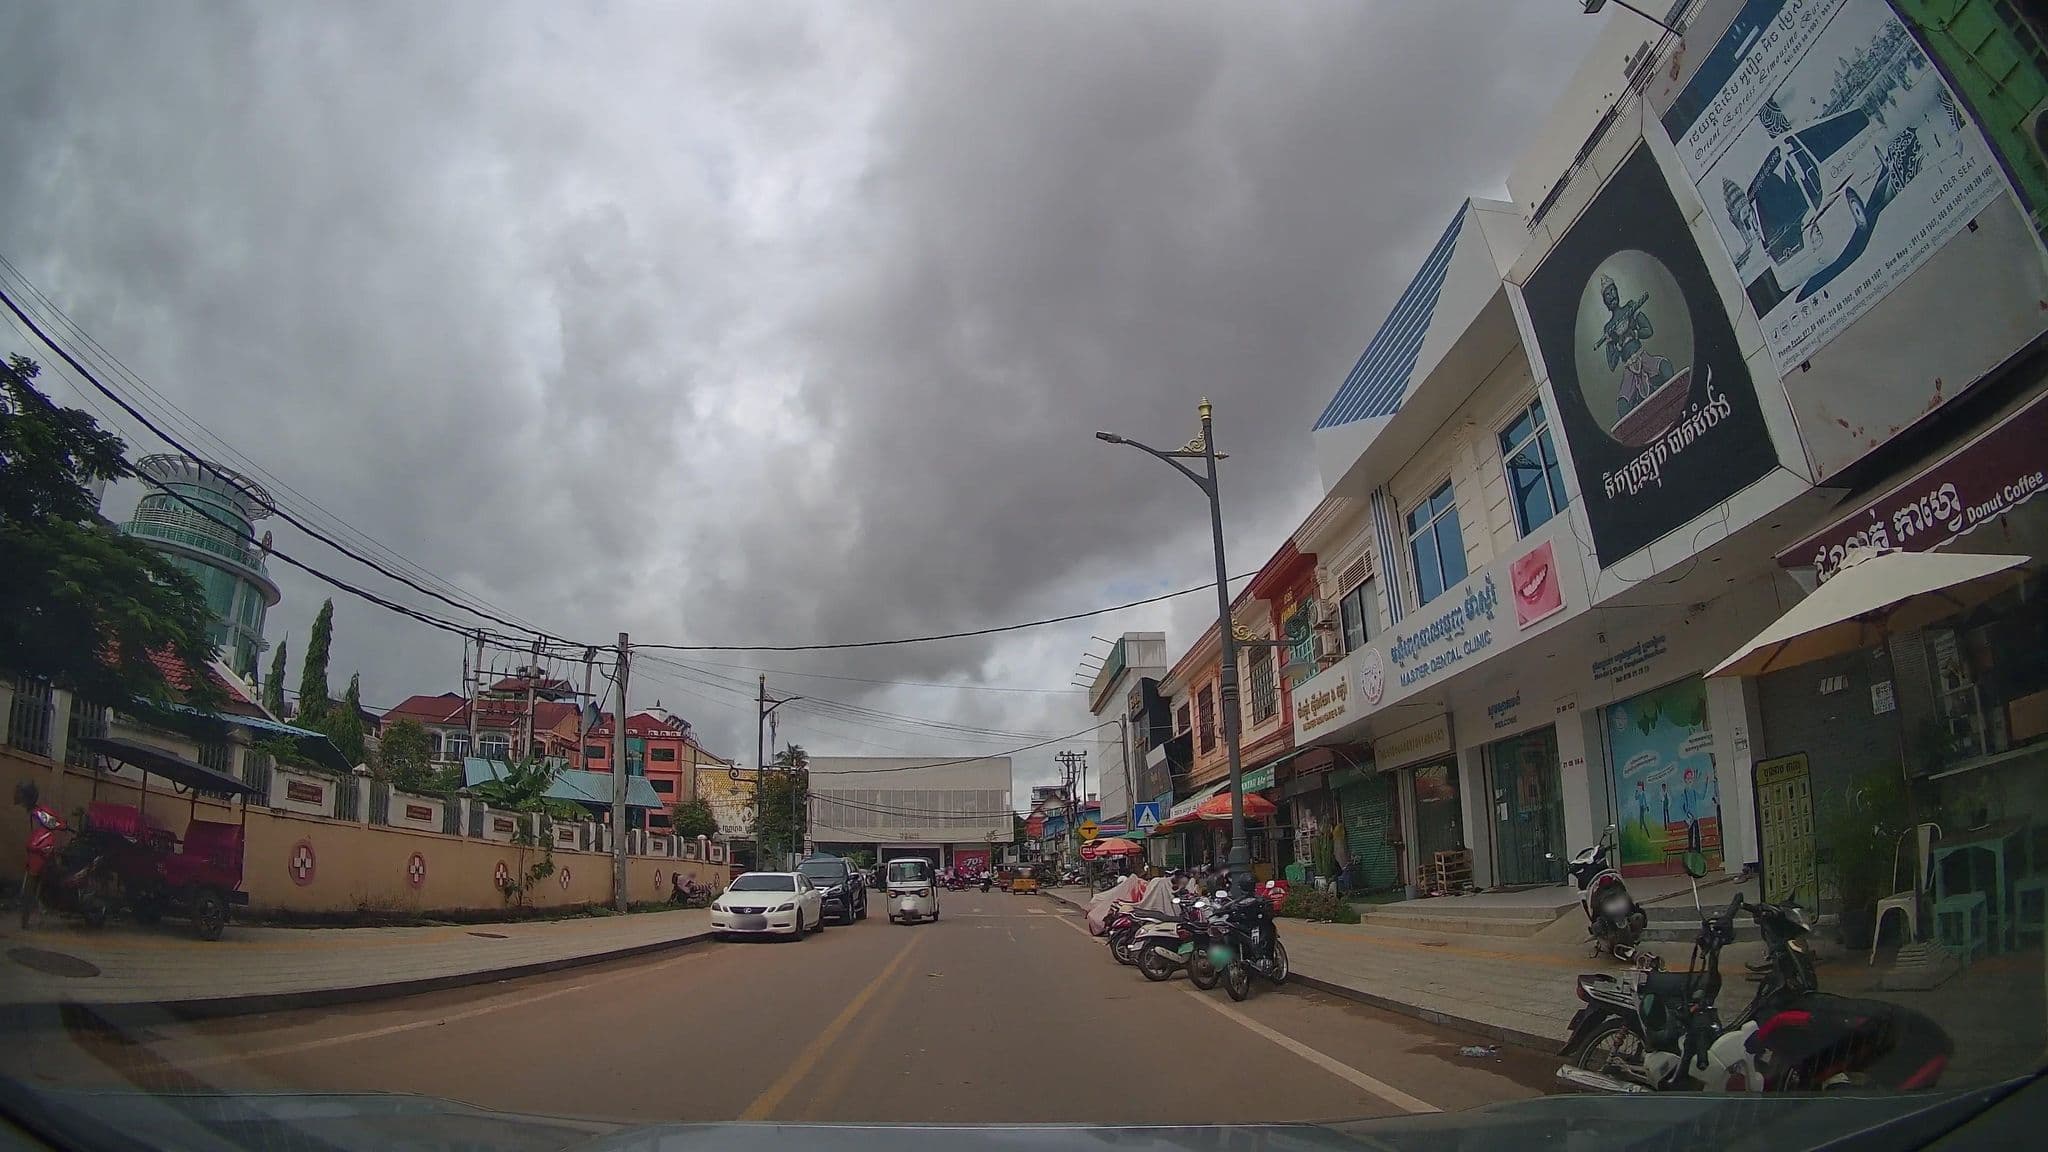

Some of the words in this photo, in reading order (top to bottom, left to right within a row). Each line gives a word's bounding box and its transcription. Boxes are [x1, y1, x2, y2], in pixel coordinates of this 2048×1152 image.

[1695, 130, 1720, 160] Orient
[1723, 87, 1757, 127] Express
[1930, 175, 1958, 204] LEADER
[1958, 157, 1977, 178] SEAT
[1967, 494, 2004, 523] Donut
[2004, 470, 2044, 502] Coffee
[1400, 662, 1430, 686] MASTER
[1430, 647, 1463, 672] DENTAL
[1464, 630, 1493, 655] CLINIC
